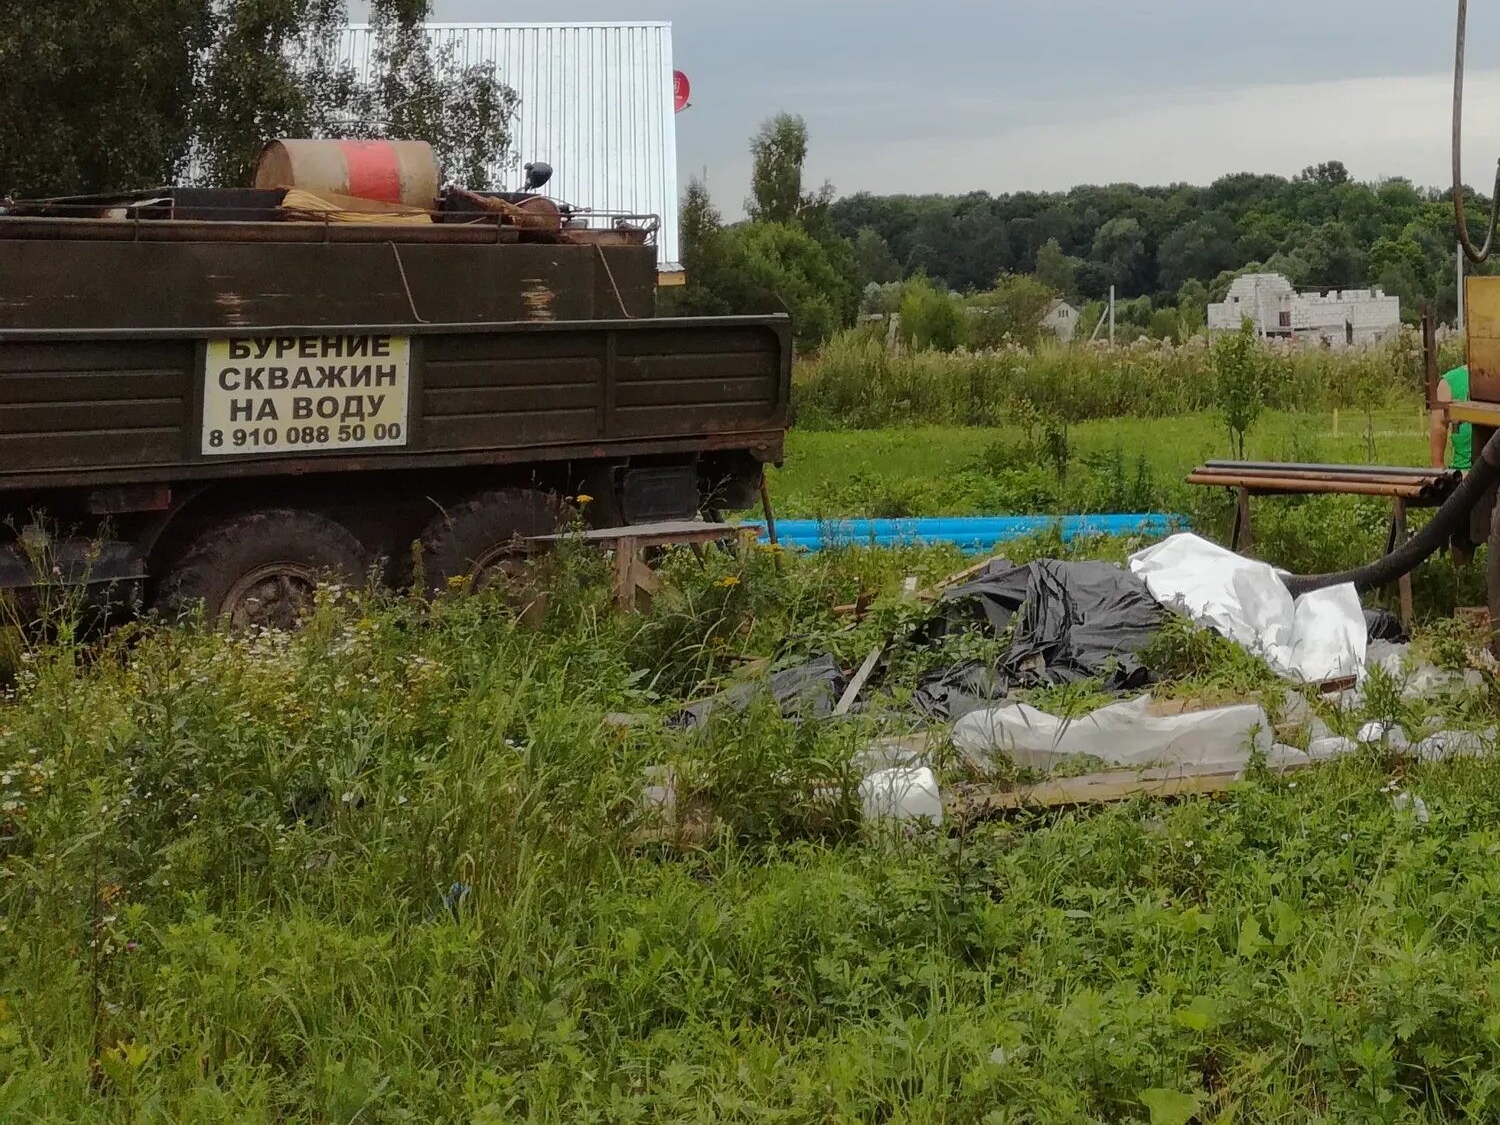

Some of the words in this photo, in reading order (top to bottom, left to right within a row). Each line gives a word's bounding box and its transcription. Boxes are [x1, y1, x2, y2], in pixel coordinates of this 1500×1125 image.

[229, 335, 390, 359] БУРЕНИЕ
[218, 364, 397, 391] СКВАЖИН
[230, 398, 279, 422] НА
[292, 395, 386, 423] ВОДУ
[208, 430, 223, 447] 8
[232, 428, 277, 446] 910
[286, 426, 330, 444] 088
[337, 424, 366, 442] 50
[373, 423, 401, 440] 00
